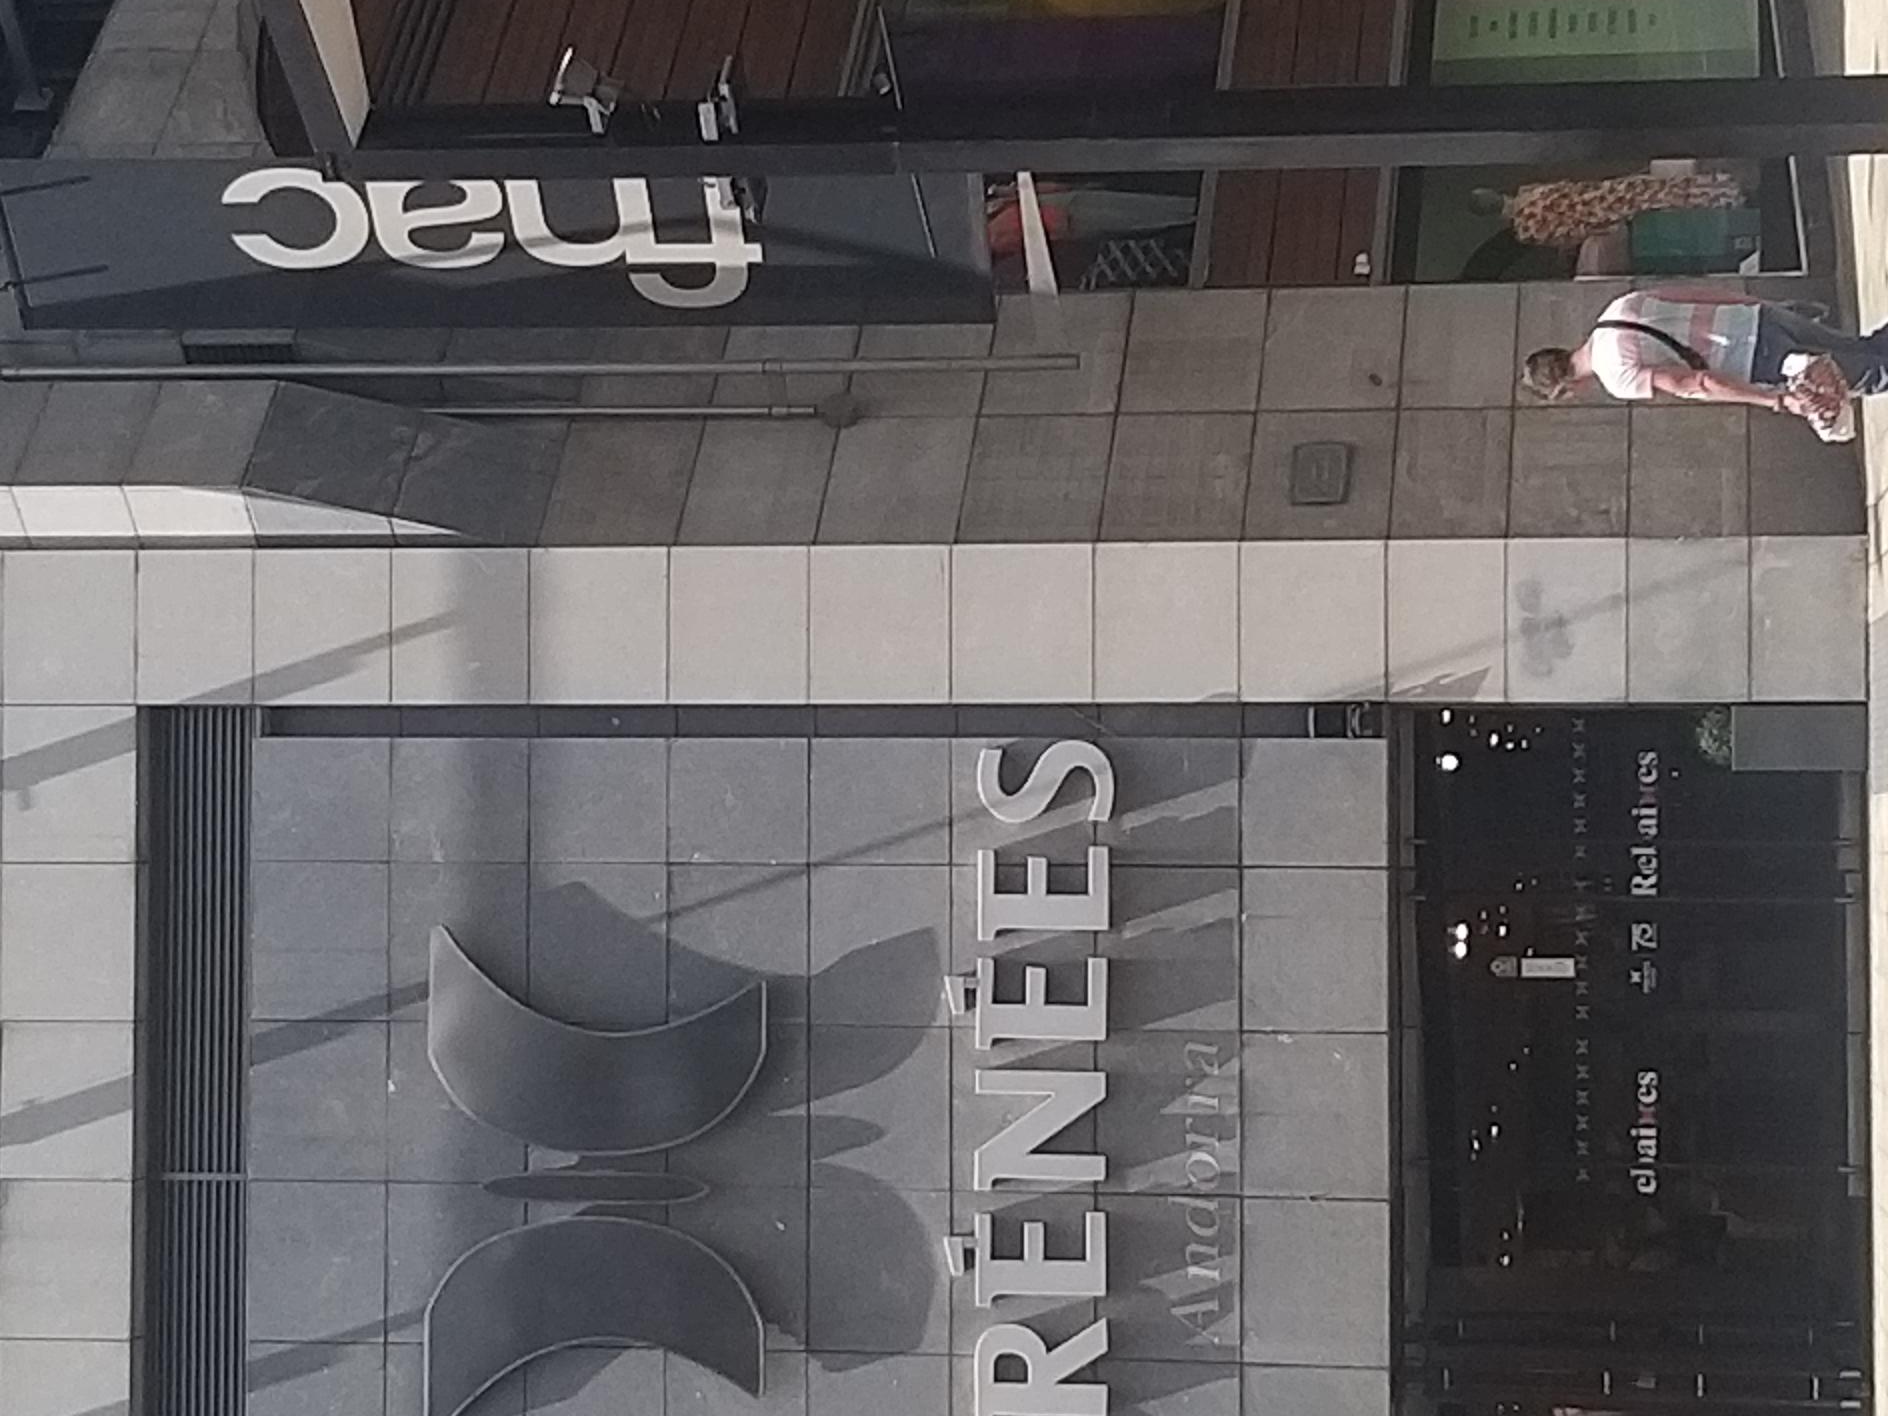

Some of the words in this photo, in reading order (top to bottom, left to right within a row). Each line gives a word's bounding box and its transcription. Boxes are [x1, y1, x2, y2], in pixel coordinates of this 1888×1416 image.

[221, 167, 762, 308] fnac
[1631, 922, 1658, 951] 75
[1167, 1040, 1221, 1346] Andorra
